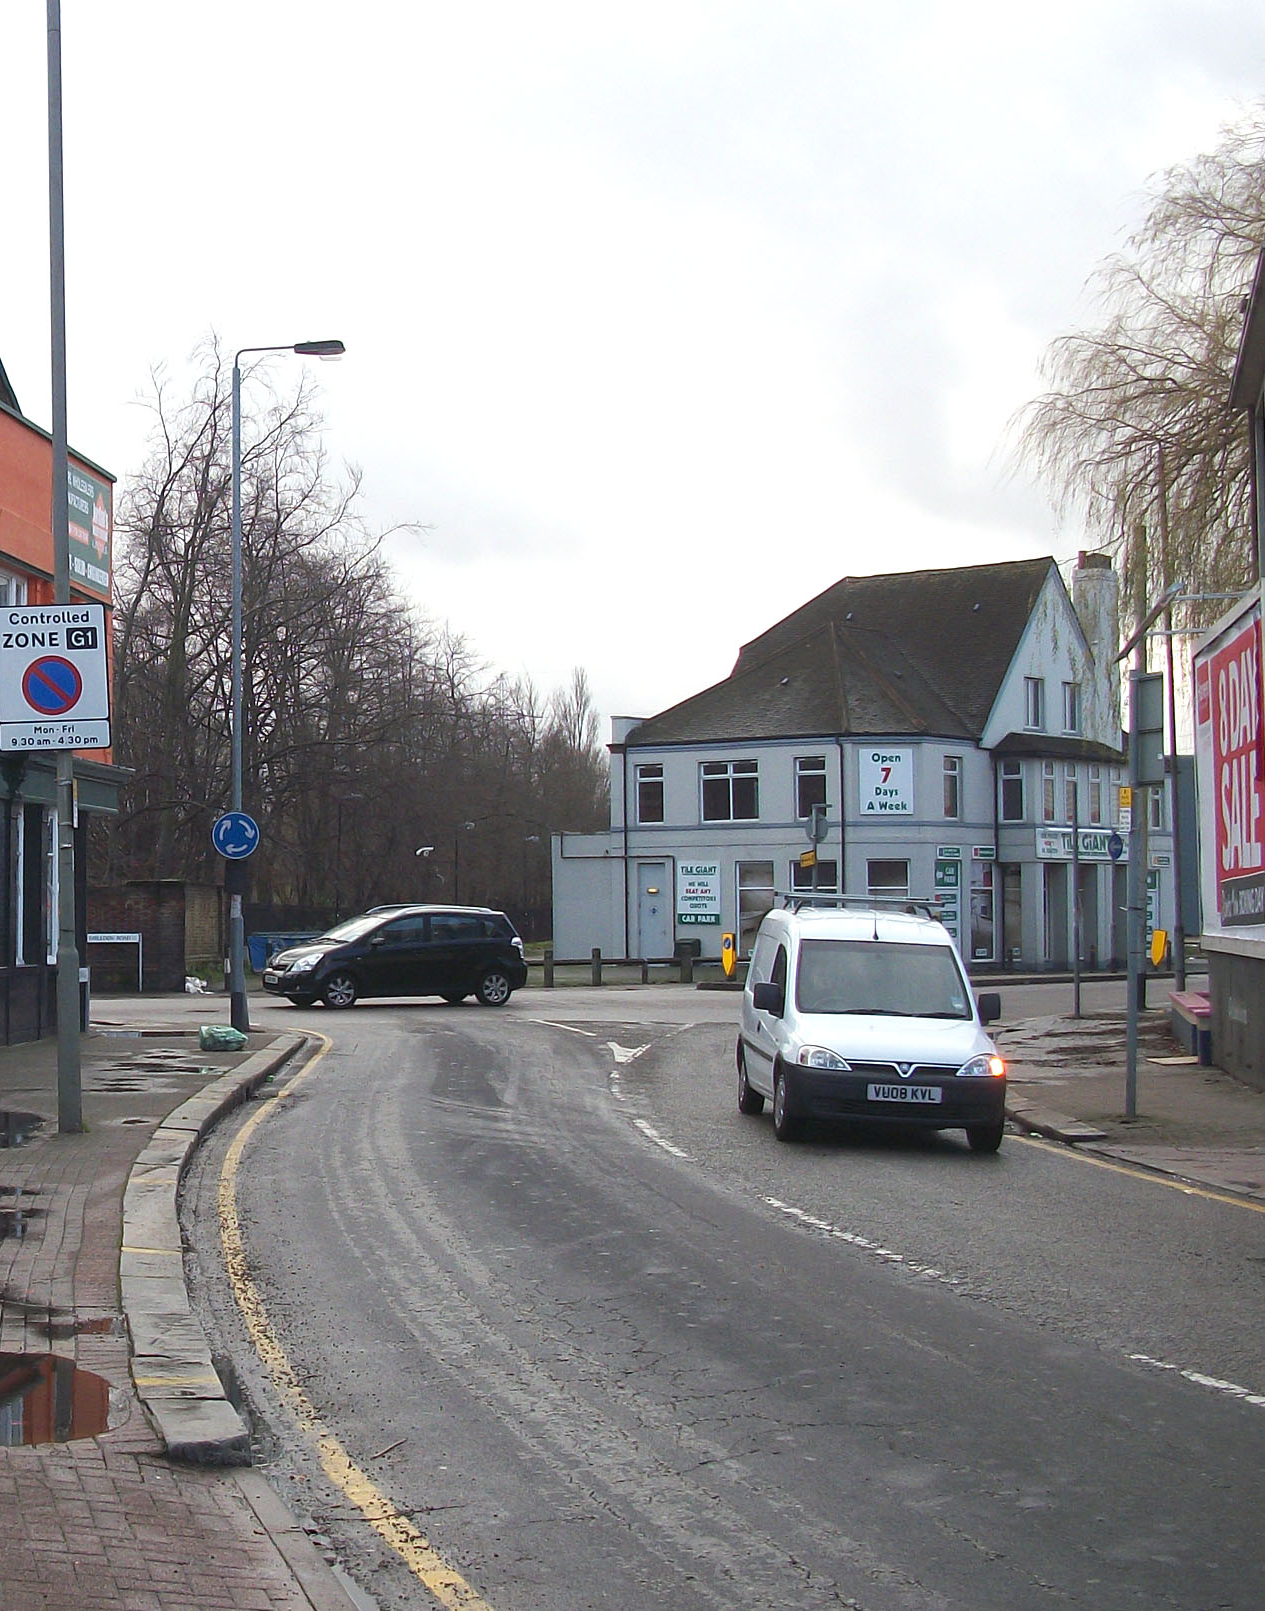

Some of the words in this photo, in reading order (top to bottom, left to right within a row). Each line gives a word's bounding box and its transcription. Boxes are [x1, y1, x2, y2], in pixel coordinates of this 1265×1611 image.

[9, 610, 90, 625] Controlled
[2, 632, 60, 649] ZONE
[71, 630, 93, 647] G1
[1218, 668, 1228, 757] 8
[33, 726, 55, 734] Mon
[61, 725, 75, 734] Fri
[11, 738, 35, 747] 9.30
[36, 738, 51, 746] am
[57, 735, 82, 745] 4.30
[83, 736, 99, 745] pm
[871, 753, 901, 764] Open
[880, 767, 892, 784] 7
[875, 786, 899, 798] Days
[866, 801, 875, 810] A
[878, 801, 907, 810] Week
[1220, 750, 1262, 872] SALE
[680, 866, 694, 874] TILE
[695, 866, 717, 874] GIANT
[681, 915, 696, 923] CAR
[874, 1085, 908, 1100] VU08
[910, 1087, 936, 1101] KVL
